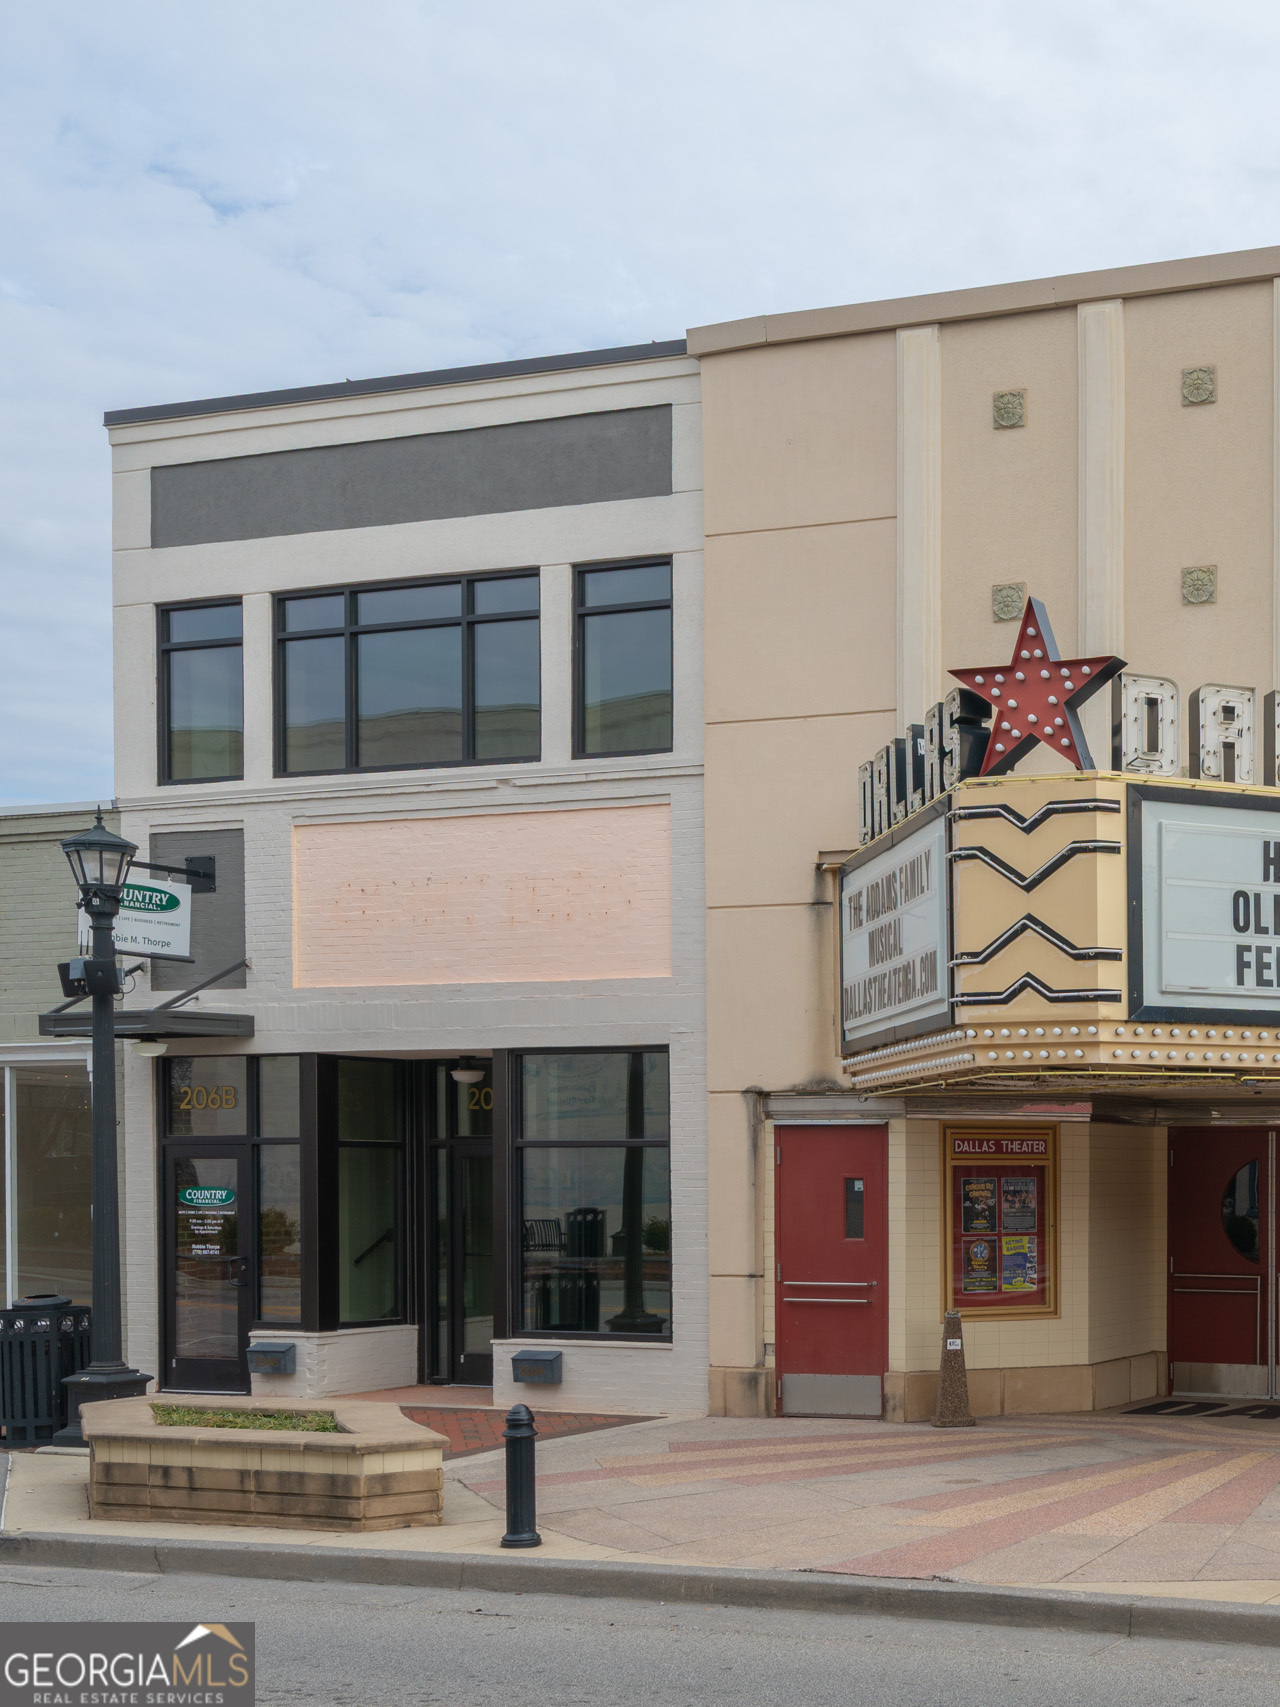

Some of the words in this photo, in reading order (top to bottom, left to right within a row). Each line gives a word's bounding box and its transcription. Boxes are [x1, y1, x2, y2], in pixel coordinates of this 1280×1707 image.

[858, 687, 962, 846] DALLAS
[119, 888, 170, 906] UNTRY
[848, 890, 863, 932] THE
[866, 870, 898, 923] ADDAMS
[898, 849, 931, 906] FAMILY
[120, 900, 158, 910] NANCIAL
[130, 935, 140, 944] M.
[142, 936, 172, 949] Thorpe
[868, 917, 903, 969] MUSICAL
[180, 1086, 236, 1110] 206B
[467, 1087, 494, 1110] 20
[955, 1140, 996, 1152] DALLAS
[1000, 1140, 1046, 1153] THEATER
[186, 1189, 228, 1199] COUNTRY
